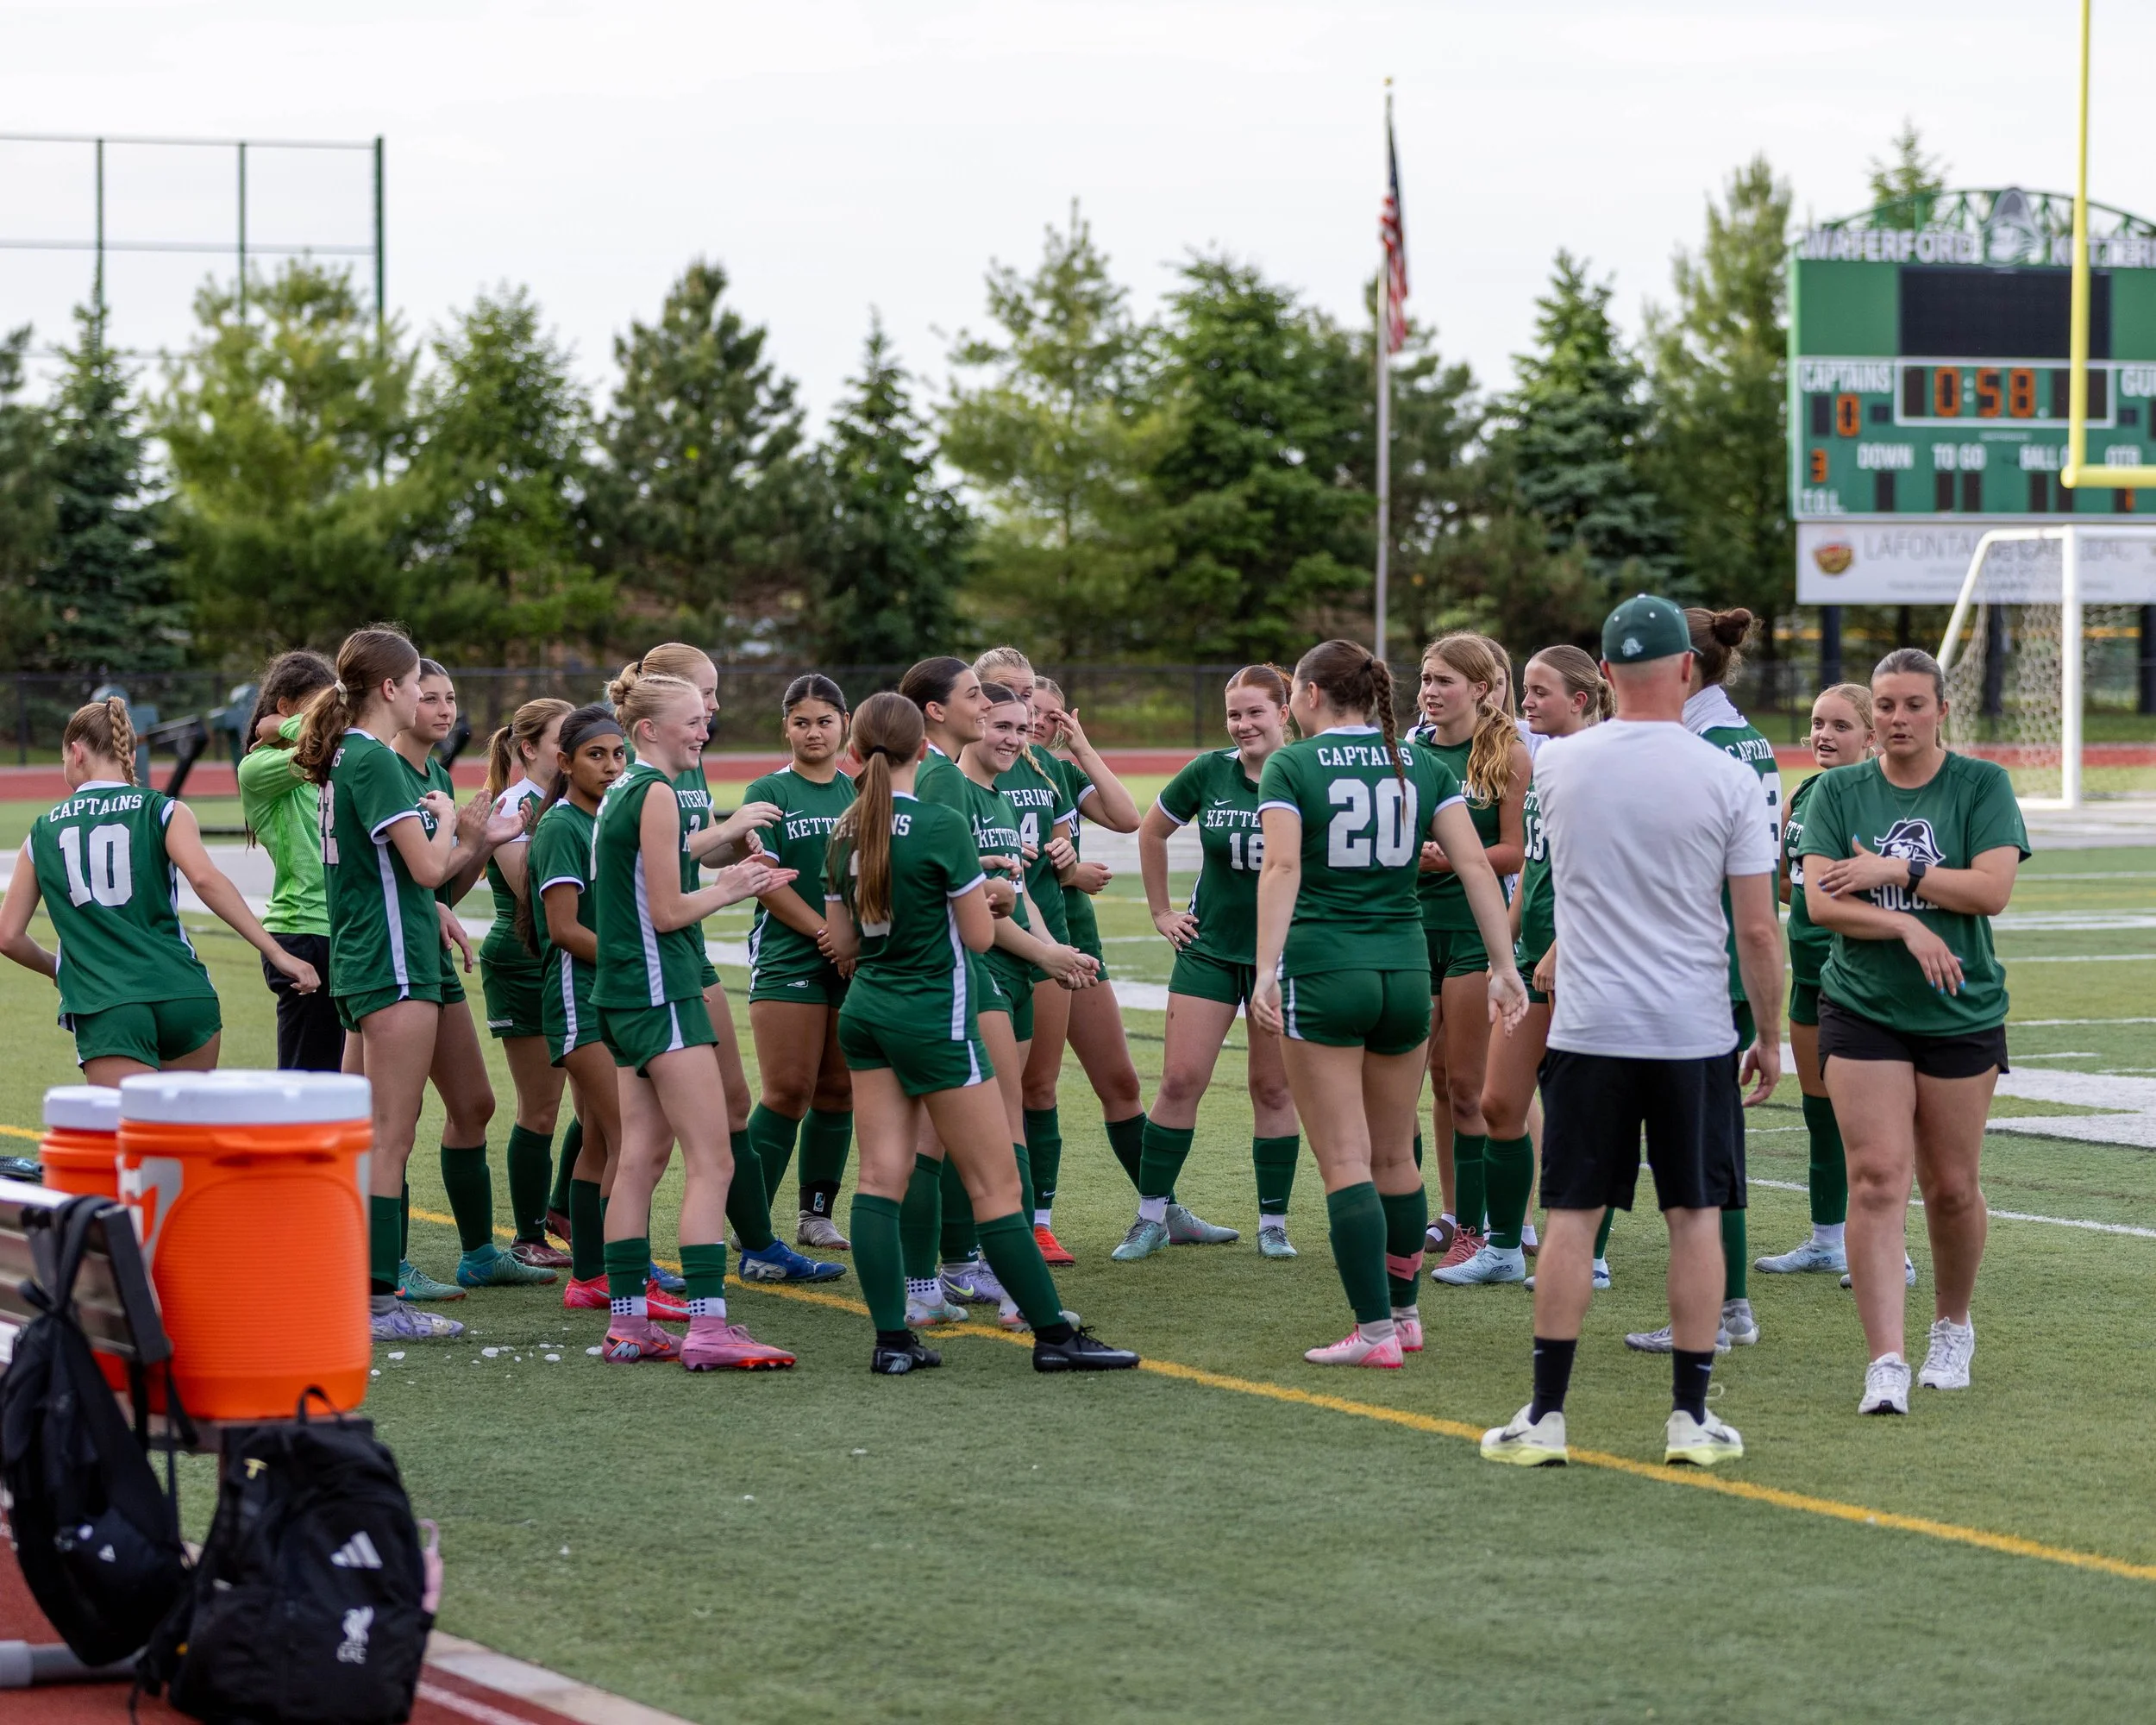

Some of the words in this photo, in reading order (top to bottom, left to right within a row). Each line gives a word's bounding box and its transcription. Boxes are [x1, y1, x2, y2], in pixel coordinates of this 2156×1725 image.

[1800, 229, 1976, 262] WATERFORD
[1802, 361, 1892, 392] CAPTAINS
[1836, 393, 1860, 437] 0
[1857, 443, 1915, 469] DOWN
[1933, 443, 1958, 470] TO
[1959, 443, 1987, 470] GO
[1317, 745, 1414, 767] CAPTAIS
[50, 794, 143, 823] CAPTAINS
[1328, 778, 1417, 868] 20
[1020, 812, 1040, 850] 4
[1525, 816, 1546, 861] 13
[59, 823, 133, 907] 10
